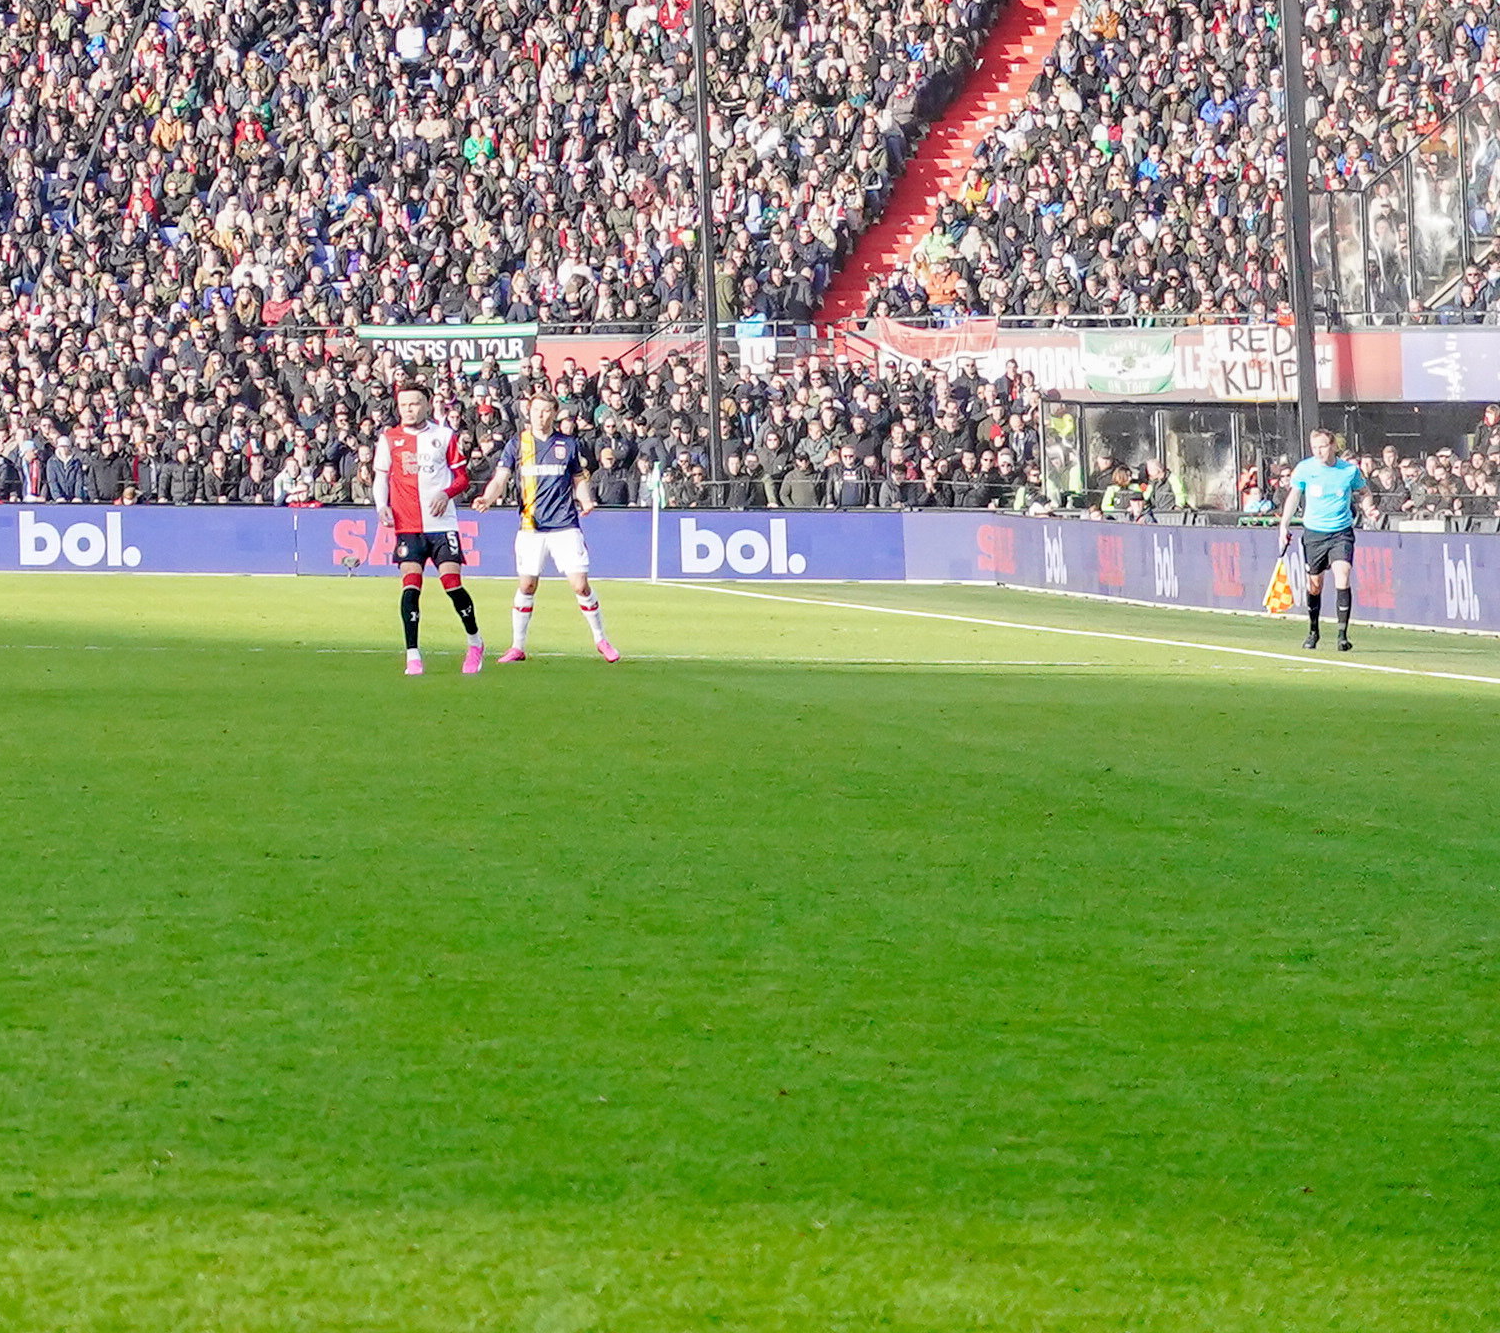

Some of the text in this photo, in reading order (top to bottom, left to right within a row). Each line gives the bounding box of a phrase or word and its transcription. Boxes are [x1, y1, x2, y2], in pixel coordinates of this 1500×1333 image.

[450, 340, 475, 361] ON
[477, 338, 524, 359] TOUR
[750, 344, 765, 365] U
[1228, 326, 1298, 355] RED
[1221, 360, 1298, 396] KUIP
[18, 510, 142, 567] bol.
[679, 517, 806, 575] bol.
[1043, 524, 1068, 585] bol.
[1153, 533, 1179, 598] bol.
[1443, 543, 1480, 621] bol.
